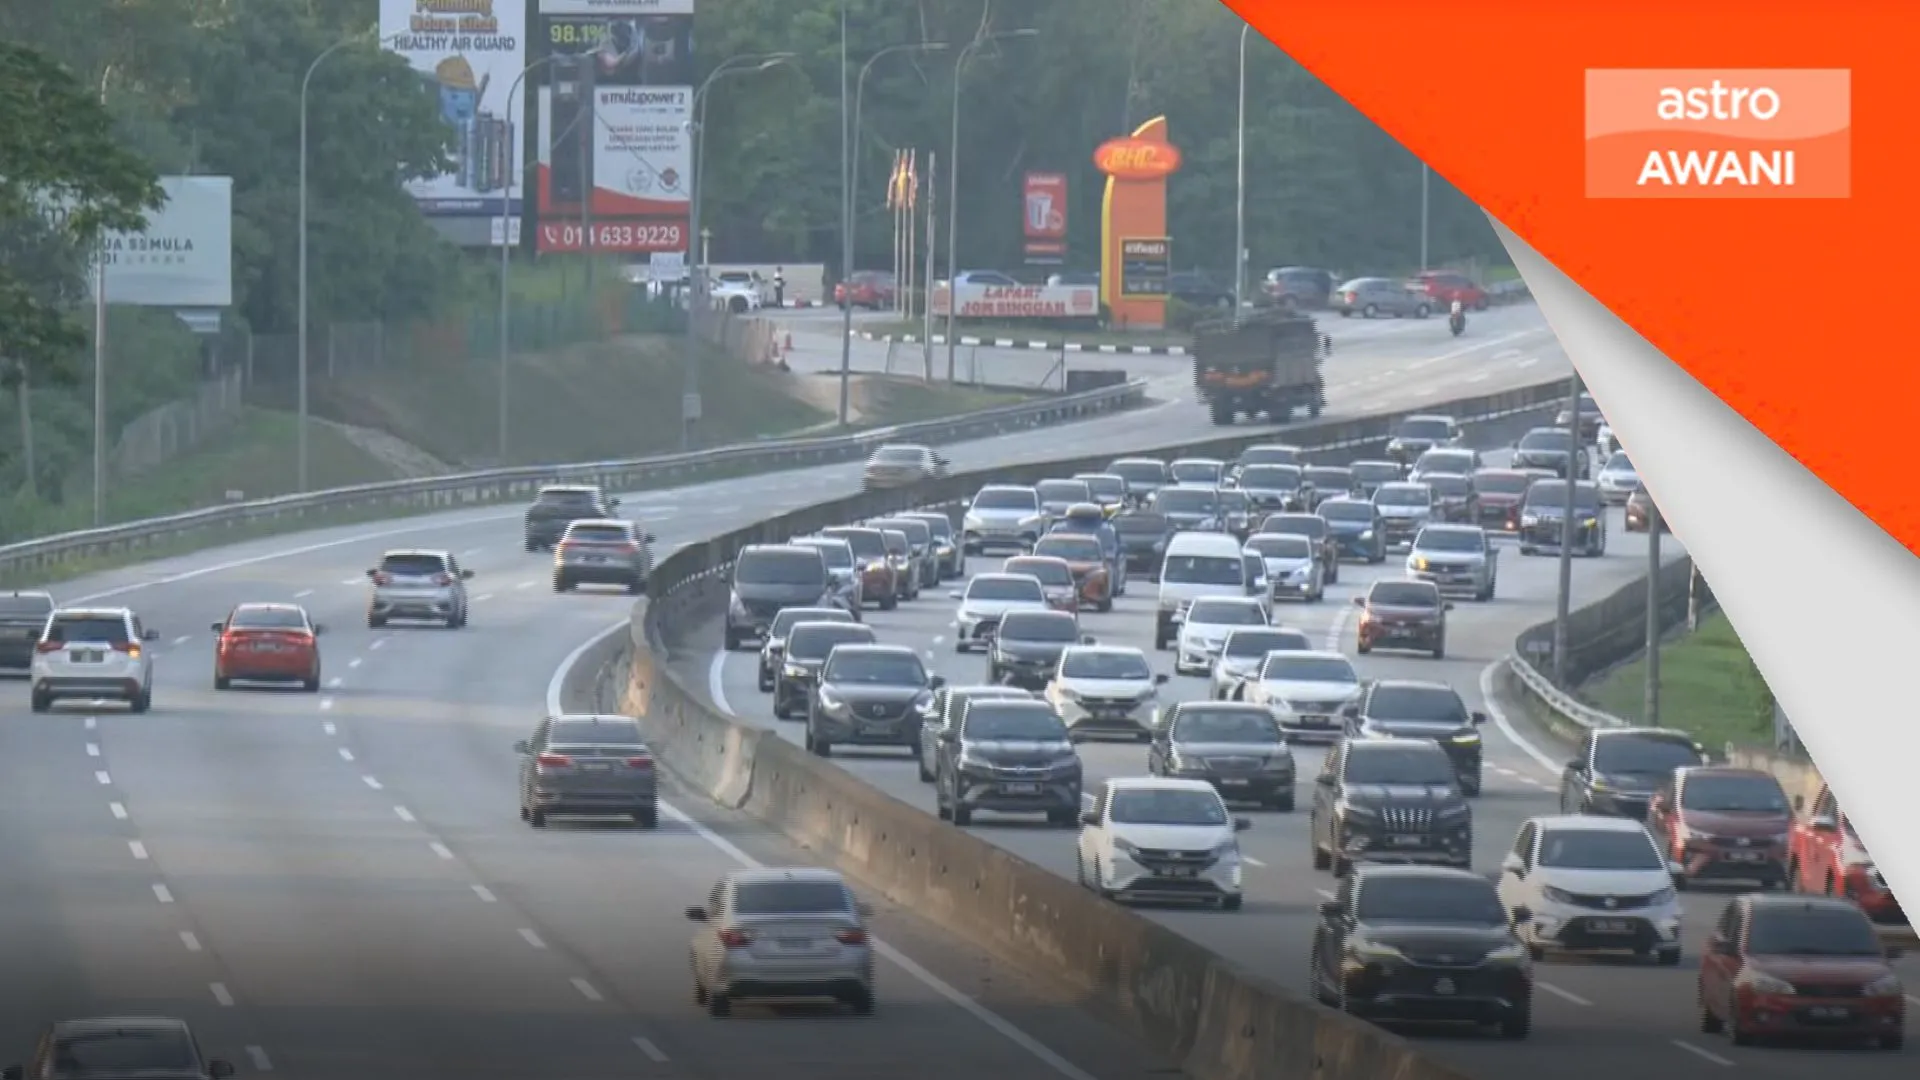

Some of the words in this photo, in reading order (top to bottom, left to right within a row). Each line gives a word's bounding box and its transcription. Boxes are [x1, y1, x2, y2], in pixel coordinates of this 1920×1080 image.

[549, 24, 605, 43] 98.1%
[394, 36, 448, 50] HEALTHY
[450, 36, 471, 50] AIR
[474, 36, 515, 51] GUARD
[600, 226, 632, 246] 633
[637, 226, 681, 246] 9229
